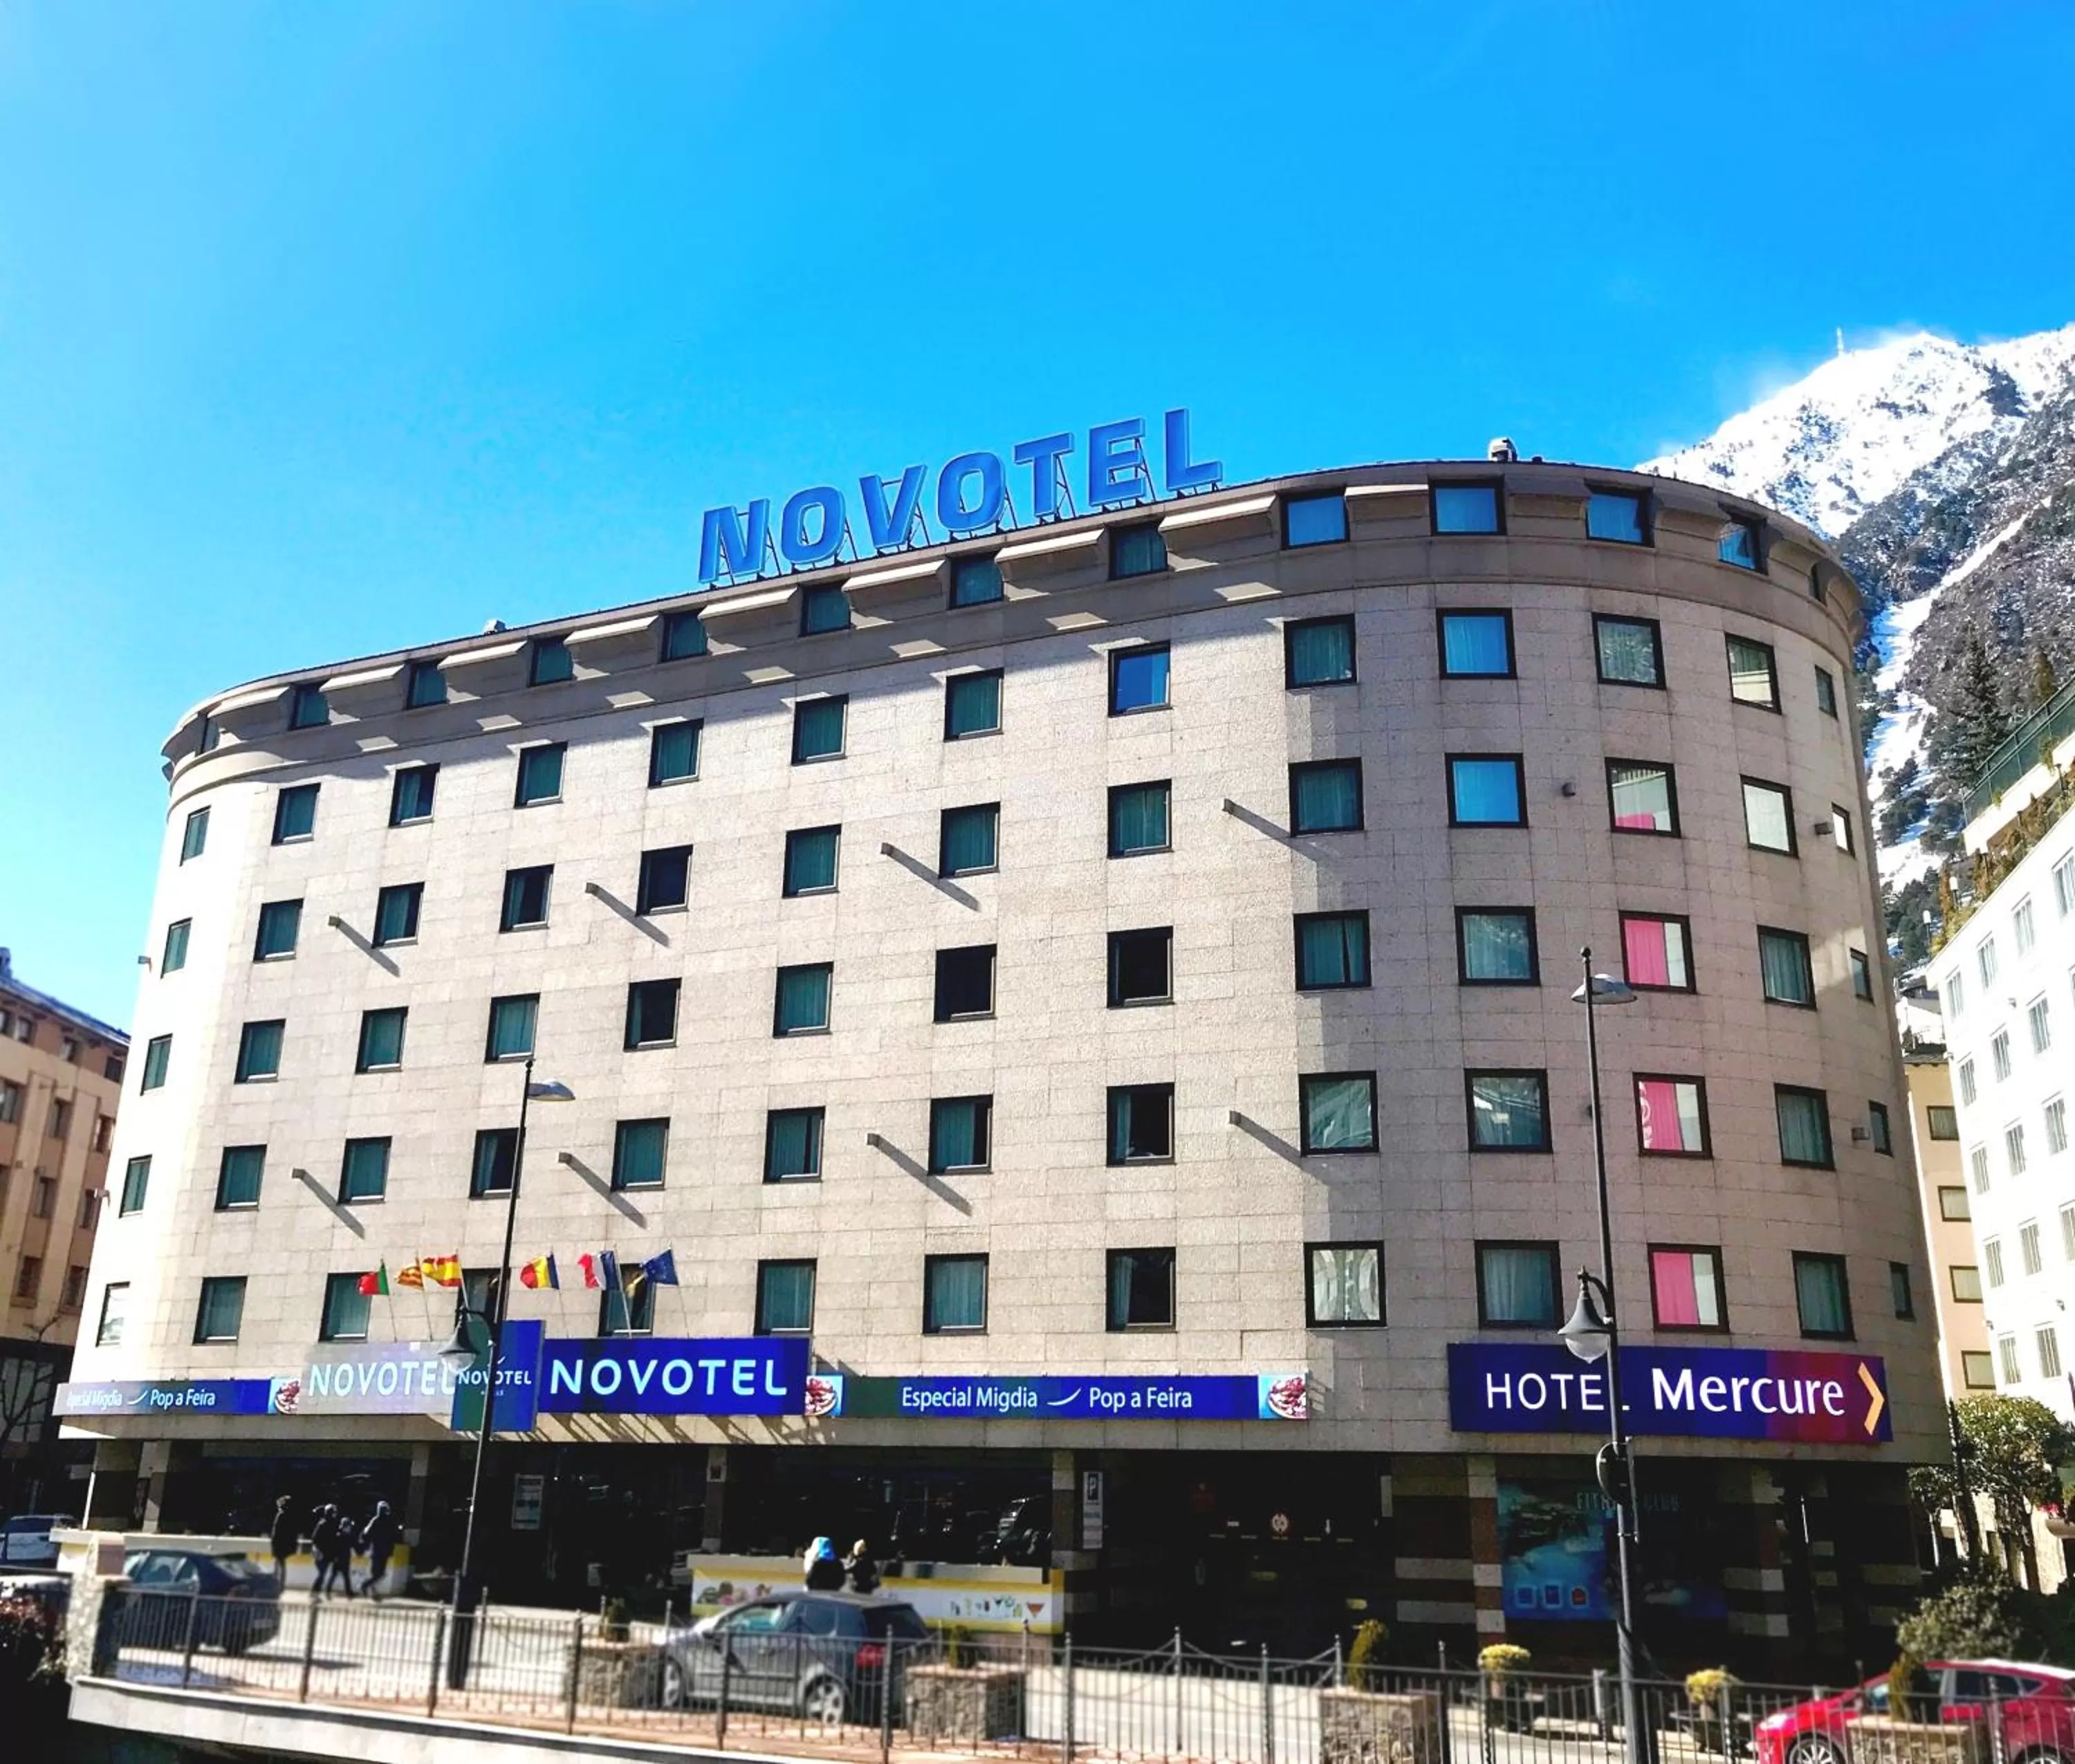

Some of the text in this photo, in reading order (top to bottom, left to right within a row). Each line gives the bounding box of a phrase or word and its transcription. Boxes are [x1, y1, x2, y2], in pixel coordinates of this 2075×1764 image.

[697, 408, 1223, 584] NOVOTEL
[308, 1360, 456, 1397] NOVOTEL
[550, 1359, 787, 1395] NOVOTEL
[1486, 1368, 1846, 1416] HOTE Mercure
[150, 1388, 174, 1410] Pop
[175, 1394, 183, 1406] a
[185, 1388, 216, 1406] Feira
[902, 1386, 1192, 1413] Especial Migdia Pop a Feira
